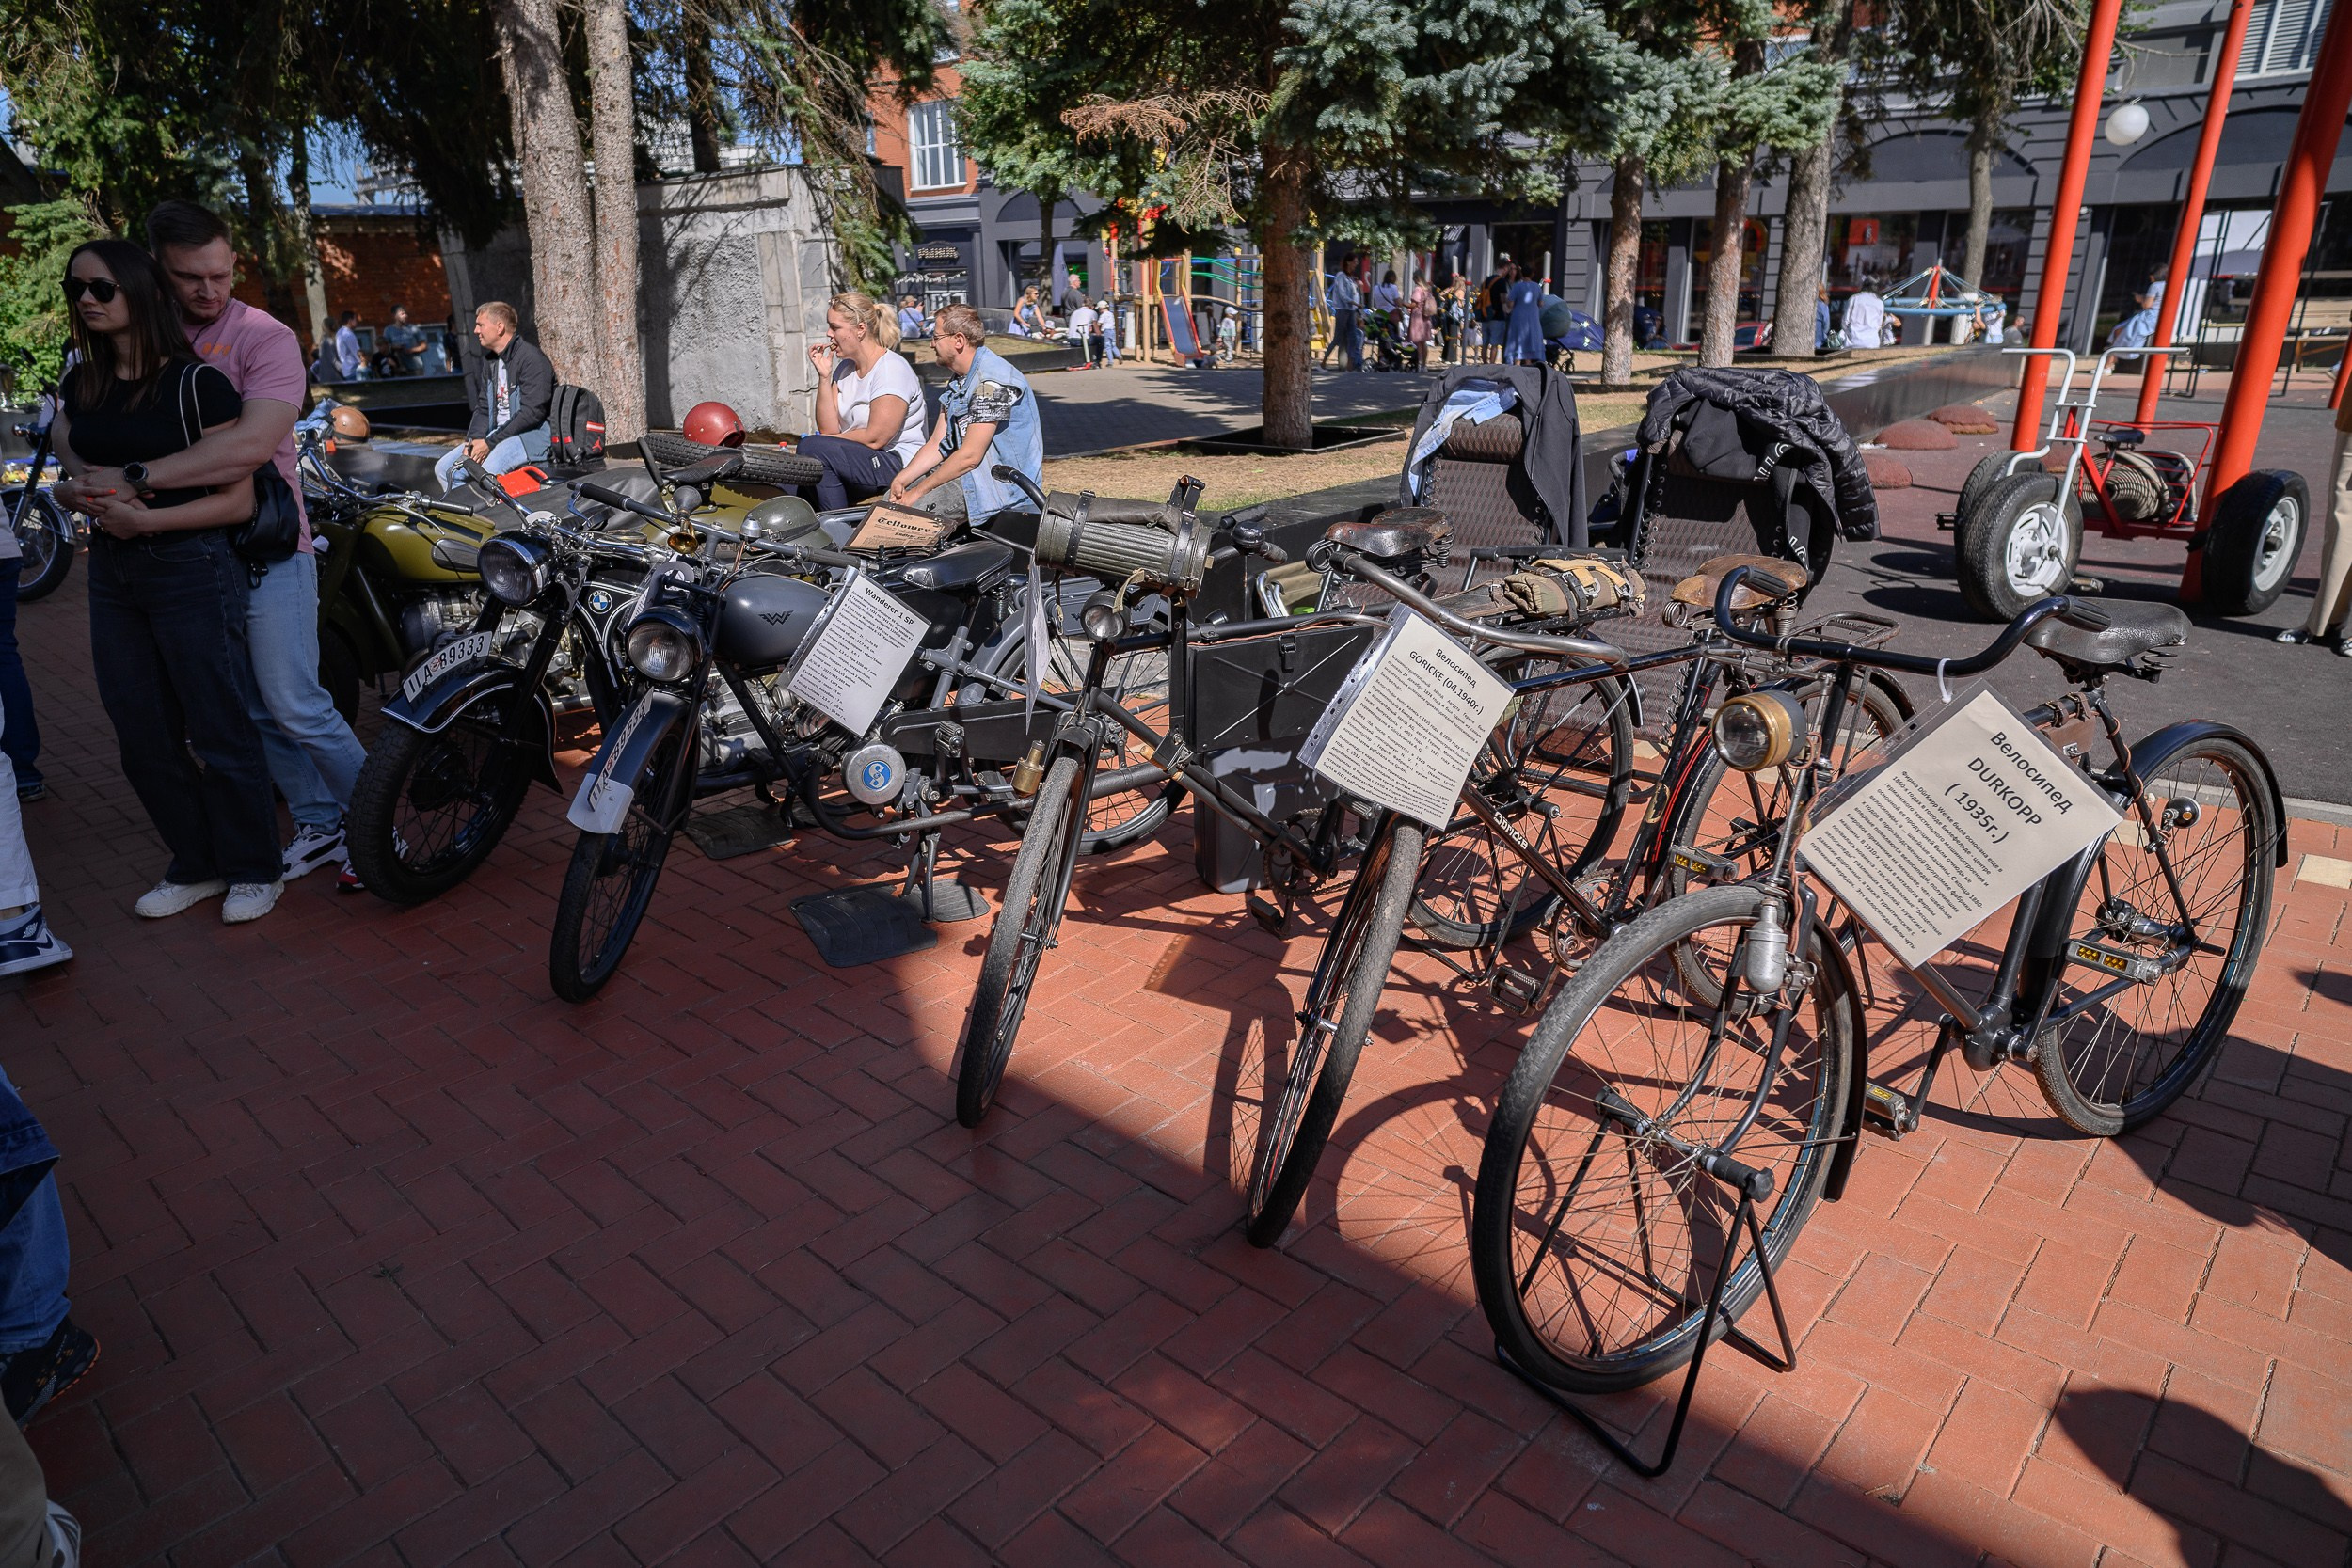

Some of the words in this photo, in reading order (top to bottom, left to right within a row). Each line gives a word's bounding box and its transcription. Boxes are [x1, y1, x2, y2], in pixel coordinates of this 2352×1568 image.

[865, 587, 898, 614] Wanderer
[903, 615, 914, 624] SP
[439, 635, 485, 669] 89333
[1409, 650, 1444, 681] GORICKE
[1442, 677, 1484, 715] (04.1940г.)
[1435, 648, 1476, 688] Велосипед
[1967, 757, 2041, 824] DURKOPP
[1990, 731, 2072, 814] Велосипед
[1876, 788, 1901, 811] основной
[1904, 816, 1935, 845] продукцией
[1932, 843, 1947, 858] были
[1945, 857, 1965, 877] отнюдь
[1884, 782, 1914, 811] германского
[1913, 810, 1945, 842] текстильного
[1943, 841, 1985, 882] машиностроения
[1901, 770, 1919, 788] Фирма
[1937, 806, 1953, 822] Werke
[1952, 821, 1966, 836] была
[1964, 835, 1988, 858] основана
[1986, 857, 1999, 868] еще
[1906, 791, 1922, 805] годах
[1924, 808, 1942, 825] городе
[1972, 856, 1991, 874] центре
[1954, 791, 2009, 843] 1935г.)
[1846, 812, 1868, 833] мировое
[1866, 832, 1892, 858] признание
[1920, 886, 1931, 897] чем
[1929, 896, 1952, 919] швейные
[1853, 806, 1875, 827] впервые
[1873, 826, 1902, 854] появляются
[1929, 882, 1959, 912] получившие
[1854, 847, 1875, 868] новинка
[1876, 869, 1886, 878] так
[1864, 804, 1880, 819] годов
[1881, 821, 1926, 864] производственной
[1923, 863, 1951, 890] программе
[1950, 889, 1972, 912] фабрики
[1878, 858, 1893, 872] годах
[1895, 875, 1919, 898] каталогах
[1917, 897, 1936, 916] фирмы
[1906, 832, 1930, 855] швейные
[1928, 854, 1950, 877] машины.
[1954, 879, 1970, 896] конца
[1863, 896, 1892, 925] велосипеды
[1891, 924, 1905, 938] были
[1865, 884, 1880, 899] также
[1877, 884, 1900, 906] моделей
[1900, 907, 1923, 929] мужские
